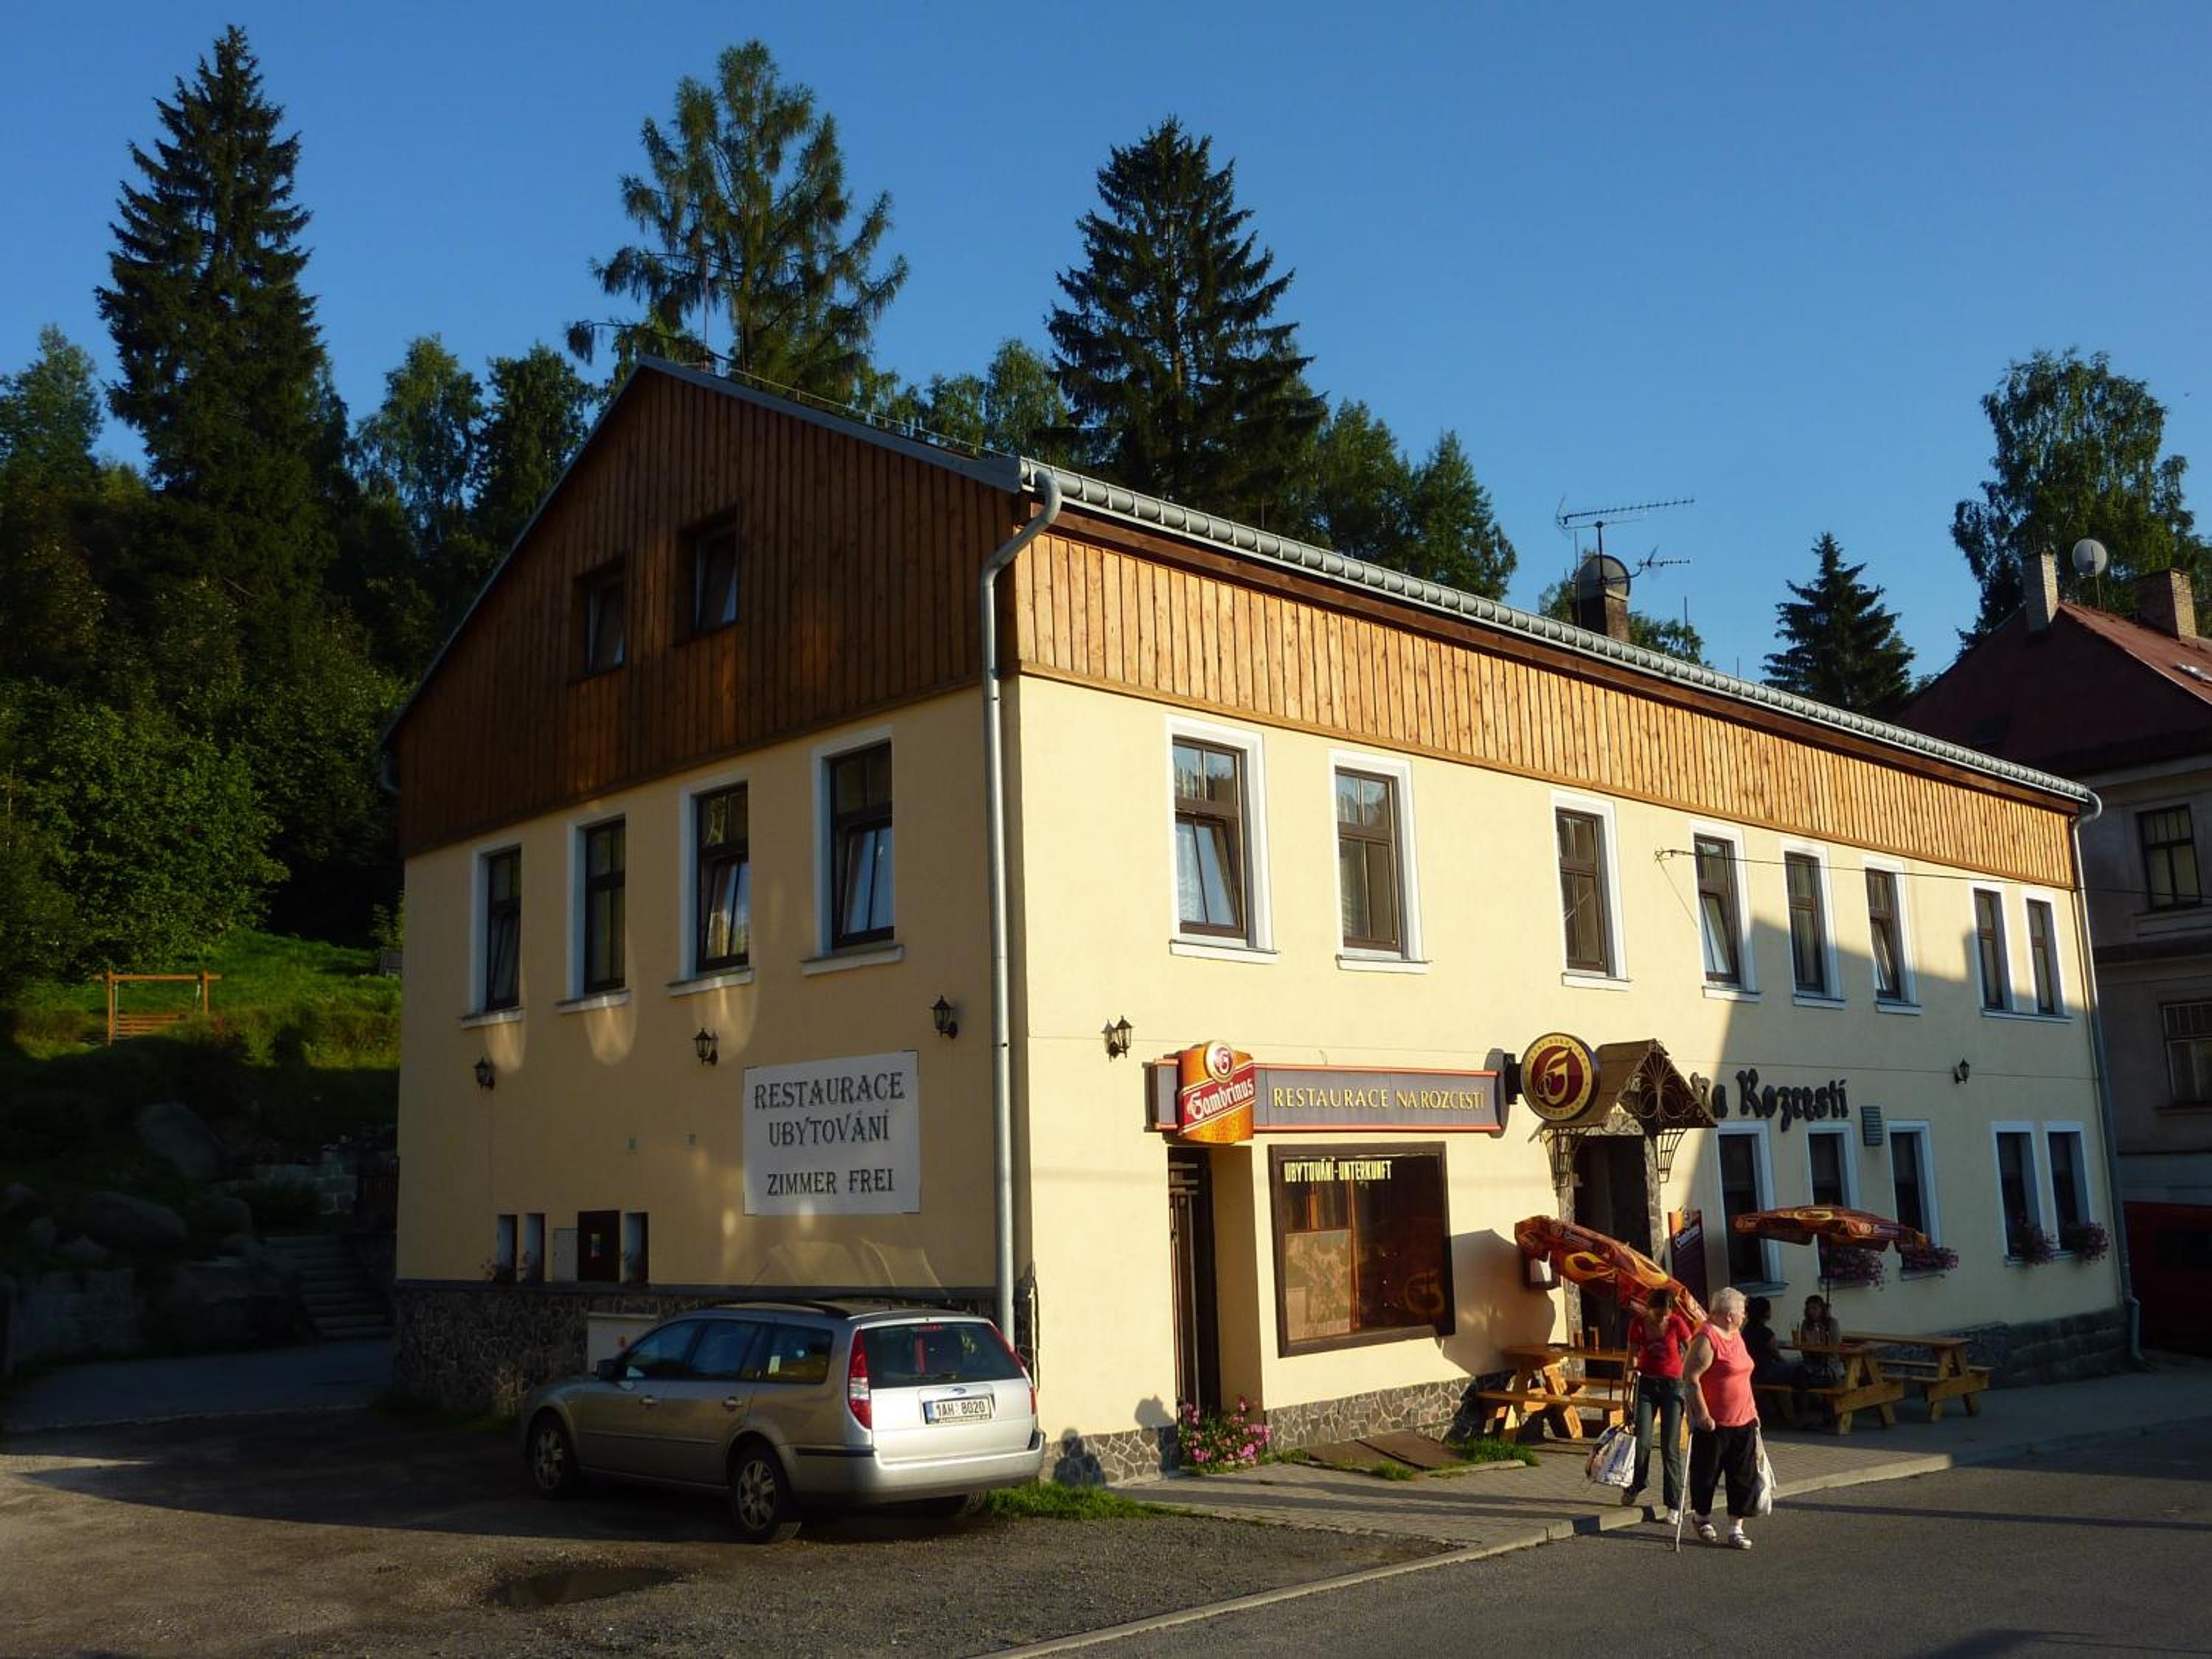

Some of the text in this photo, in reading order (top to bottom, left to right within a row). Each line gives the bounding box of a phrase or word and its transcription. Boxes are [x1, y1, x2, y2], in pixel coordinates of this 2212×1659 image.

[754, 1072, 905, 1109] RESTAURACE
[1186, 1078, 1254, 1120] Gambrinus
[1273, 1088, 1389, 1108] RESTAURACE
[1395, 1090, 1418, 1108] NA
[769, 1108, 890, 1147] UBYTOVÁNÍ
[766, 1168, 896, 1196] ZIMMER FREI
